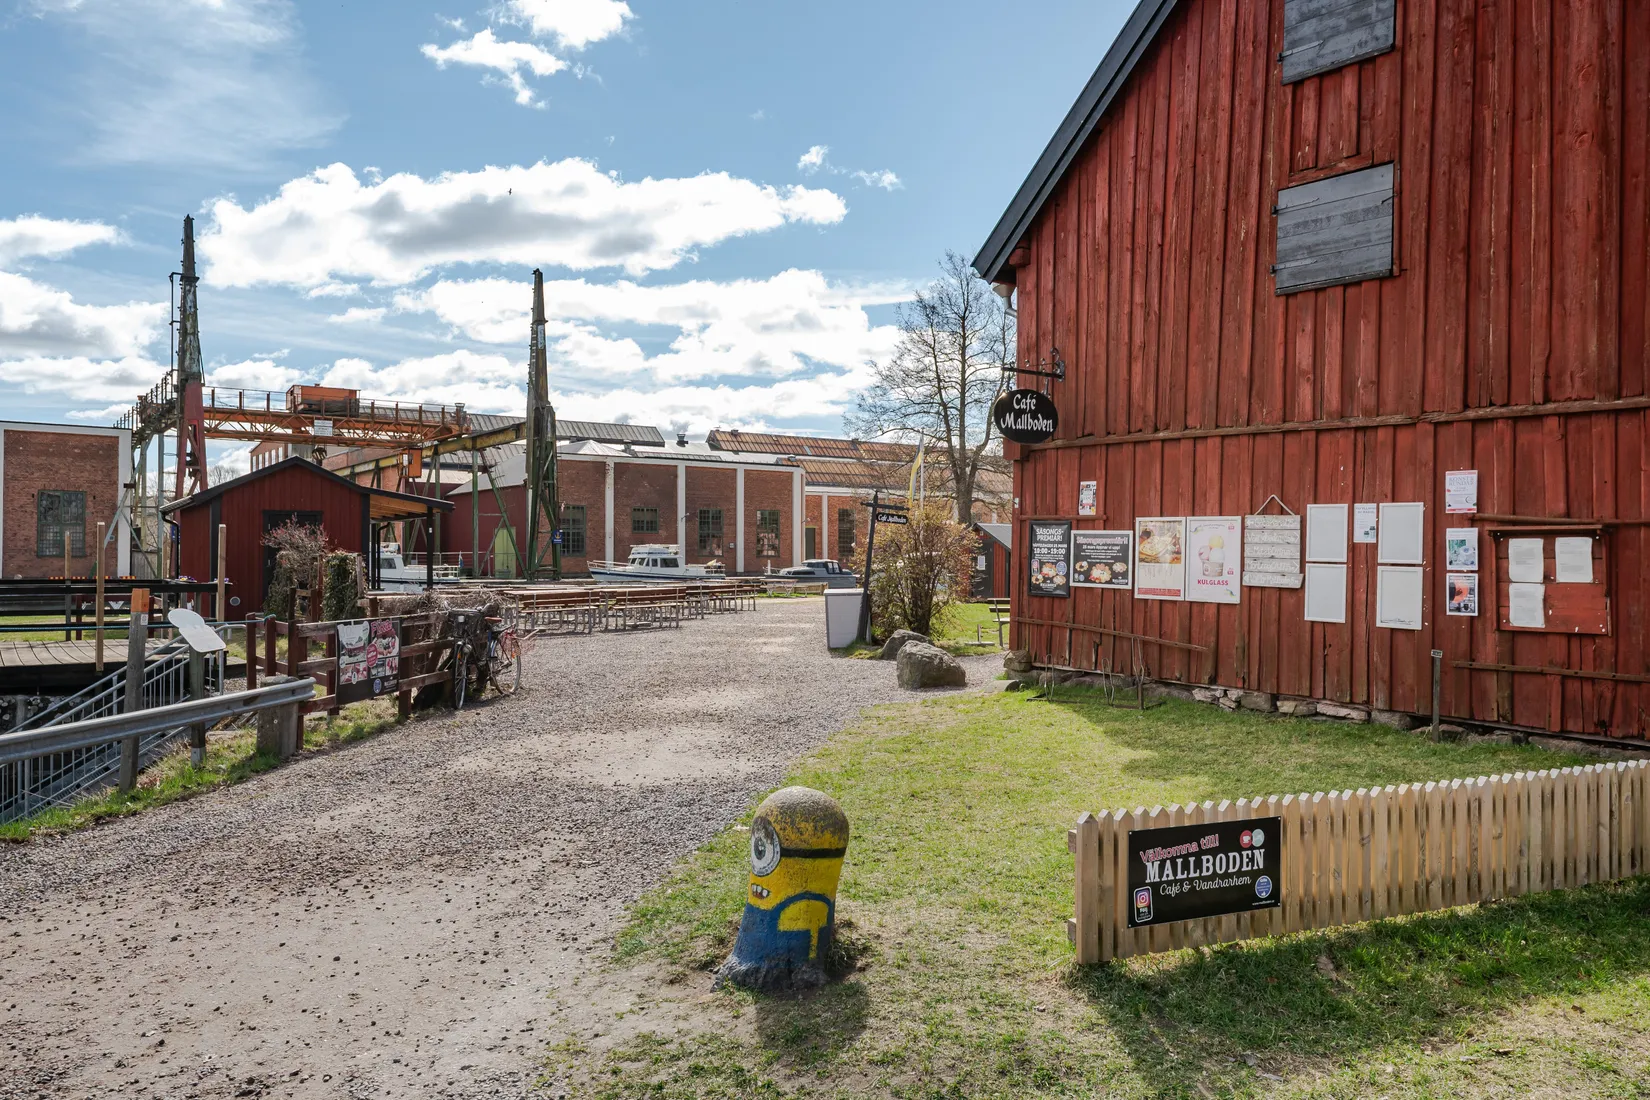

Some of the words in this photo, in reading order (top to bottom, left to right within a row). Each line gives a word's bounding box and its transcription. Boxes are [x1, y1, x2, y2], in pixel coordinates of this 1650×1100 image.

[1013, 393, 1036, 412] Café
[1000, 412, 1053, 432] Mallboden
[1140, 841, 1199, 863] Välkomna
[1145, 849, 1265, 883] MALLBODEN
[1160, 882, 1182, 898] Café
[1182, 880, 1191, 892] &
[1193, 875, 1252, 891] Vandrarhem
